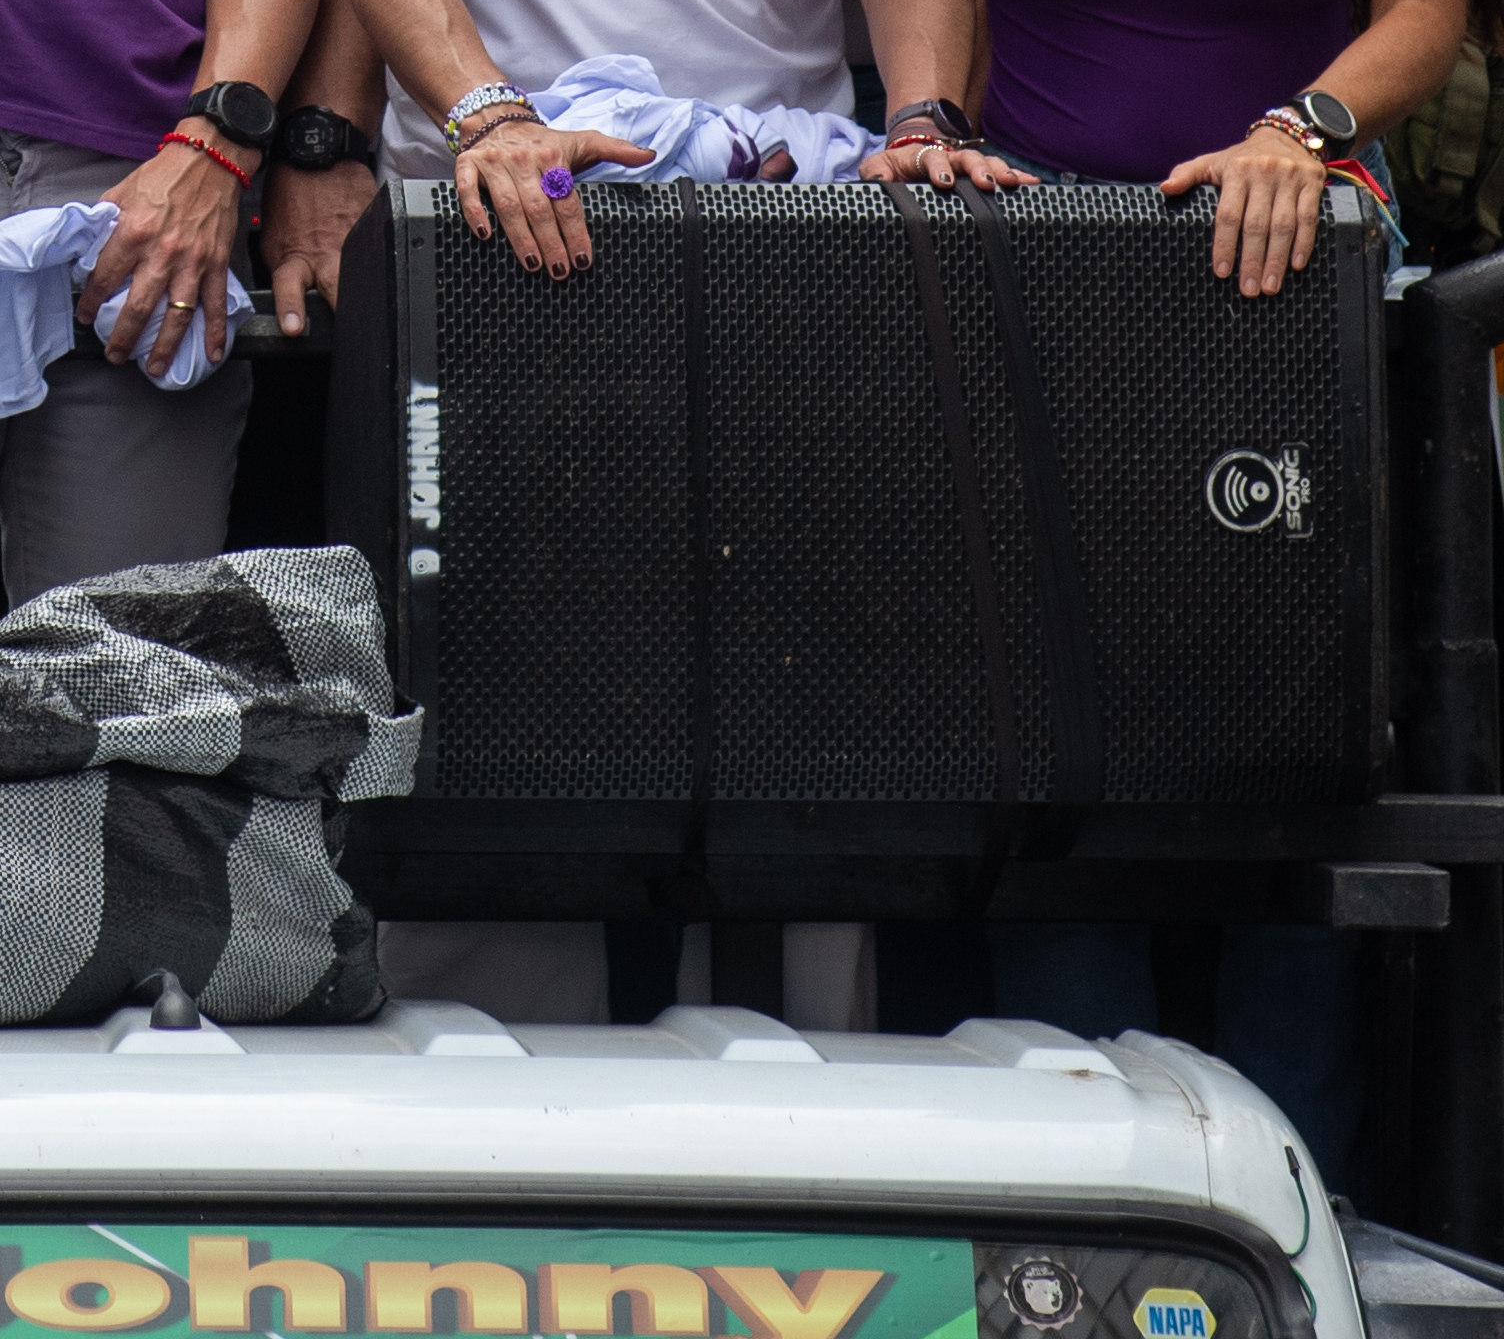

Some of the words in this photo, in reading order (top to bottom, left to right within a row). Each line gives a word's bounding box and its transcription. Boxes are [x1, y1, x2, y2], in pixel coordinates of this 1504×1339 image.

[1284, 449, 1302, 531] SONIC
[1300, 477, 1311, 503] PRO
[1149, 1306, 1206, 1337] NAPA
